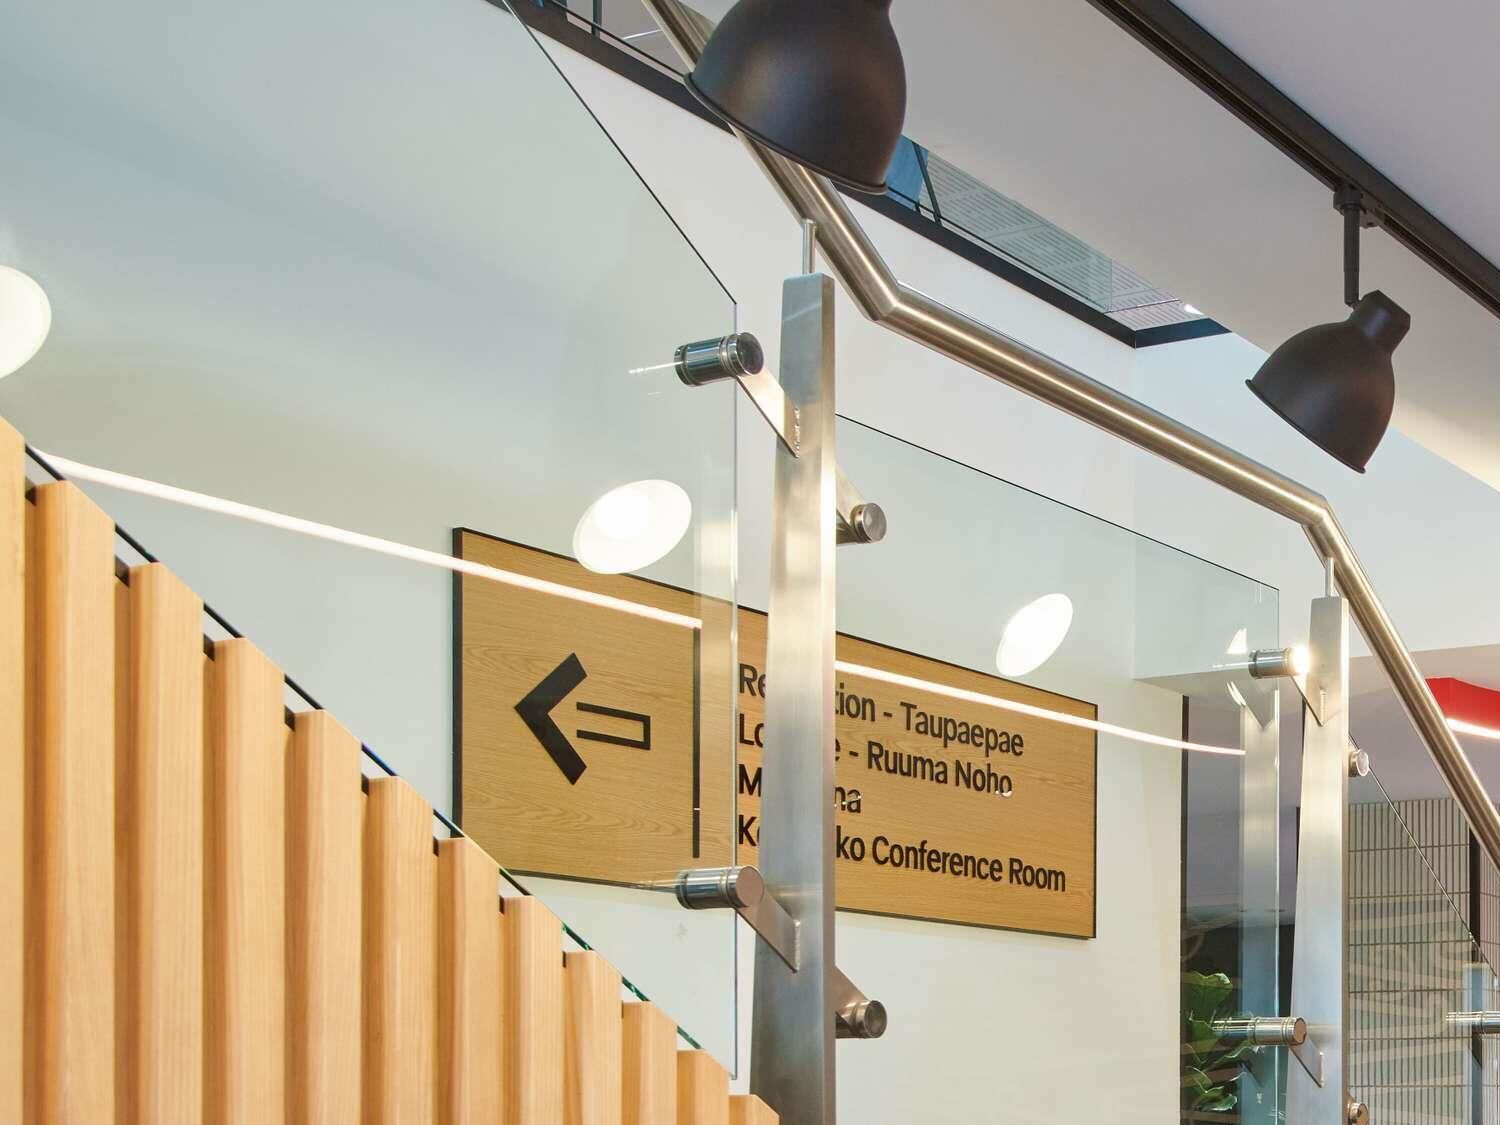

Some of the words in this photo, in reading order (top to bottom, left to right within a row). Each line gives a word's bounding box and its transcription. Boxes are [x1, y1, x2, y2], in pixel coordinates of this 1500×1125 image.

[900, 701, 1024, 757] Taupaepae
[867, 740, 948, 785] Ruuma
[955, 760, 1013, 797] Noho
[872, 835, 1003, 882] Conference
[1009, 857, 1066, 892] Room
